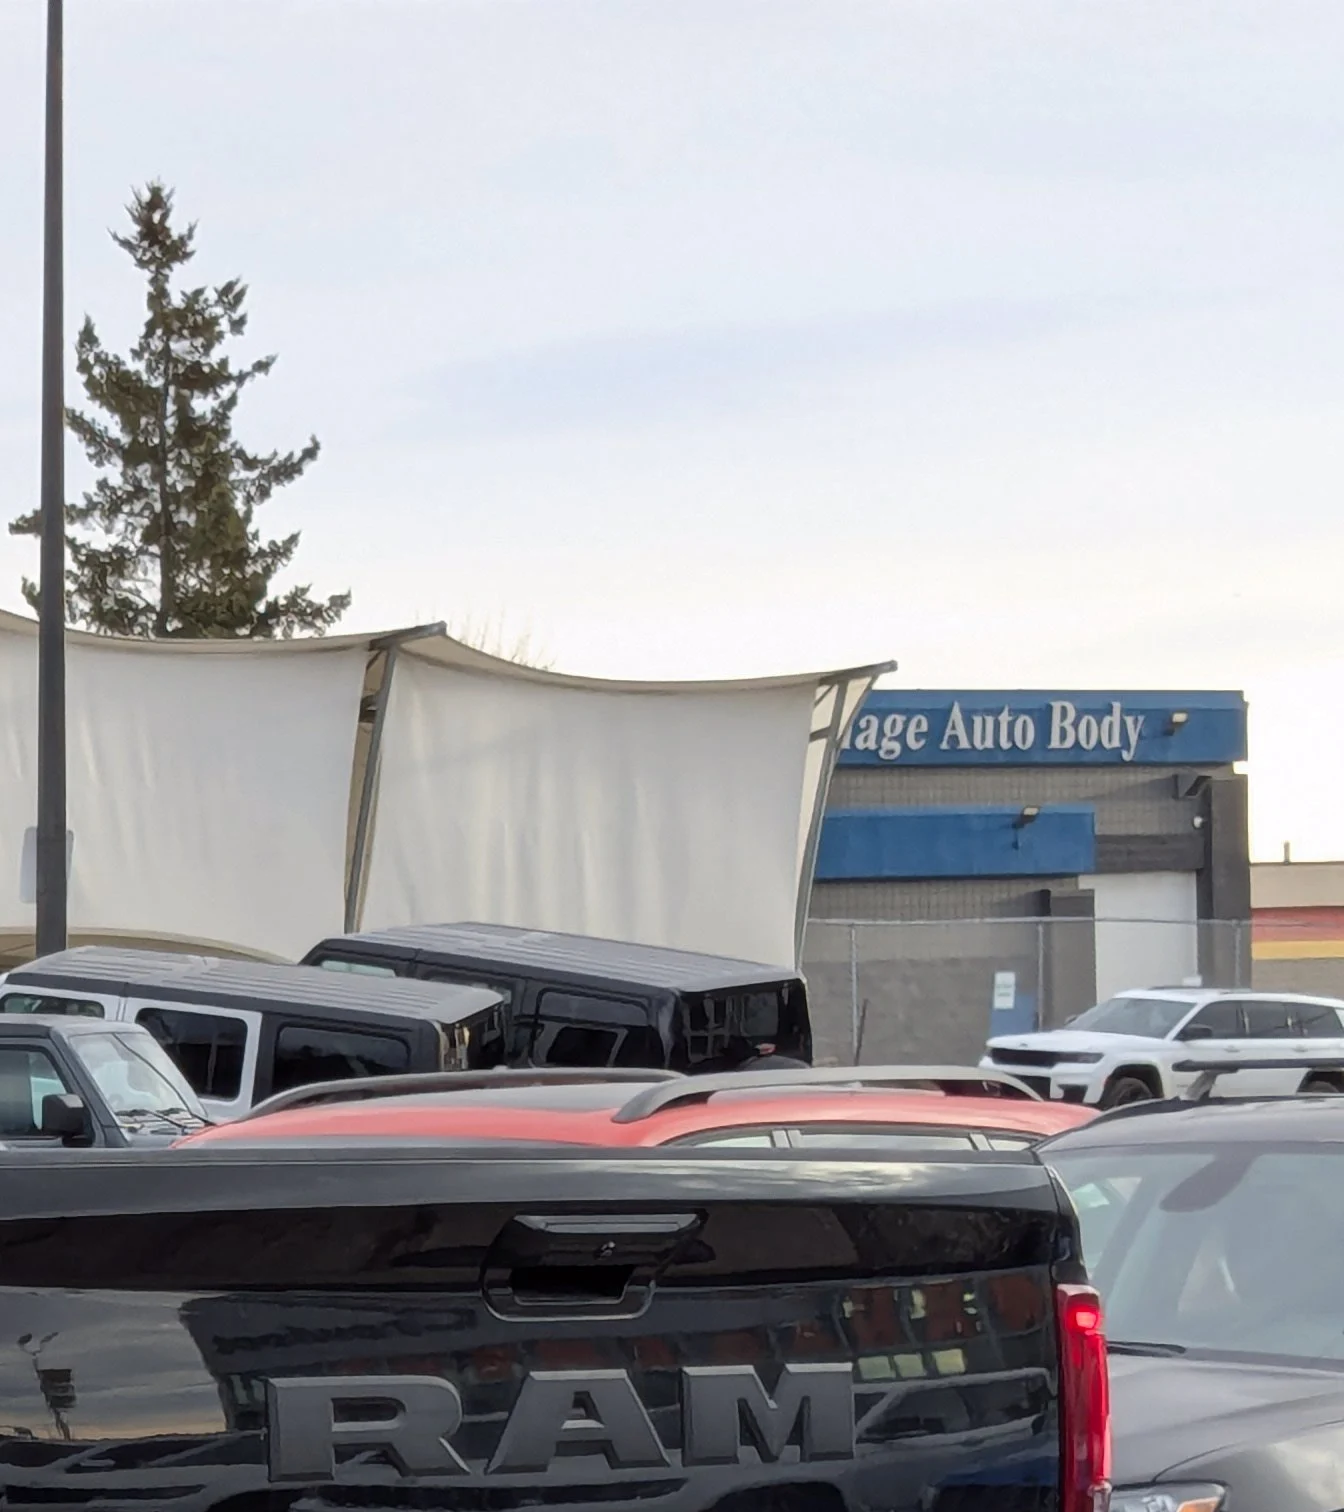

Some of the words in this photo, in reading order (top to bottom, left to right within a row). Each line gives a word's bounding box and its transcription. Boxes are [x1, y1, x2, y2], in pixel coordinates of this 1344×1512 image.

[940, 700, 1035, 750] Auto
[1047, 700, 1145, 761] Body
[265, 1362, 856, 1483] RAM
